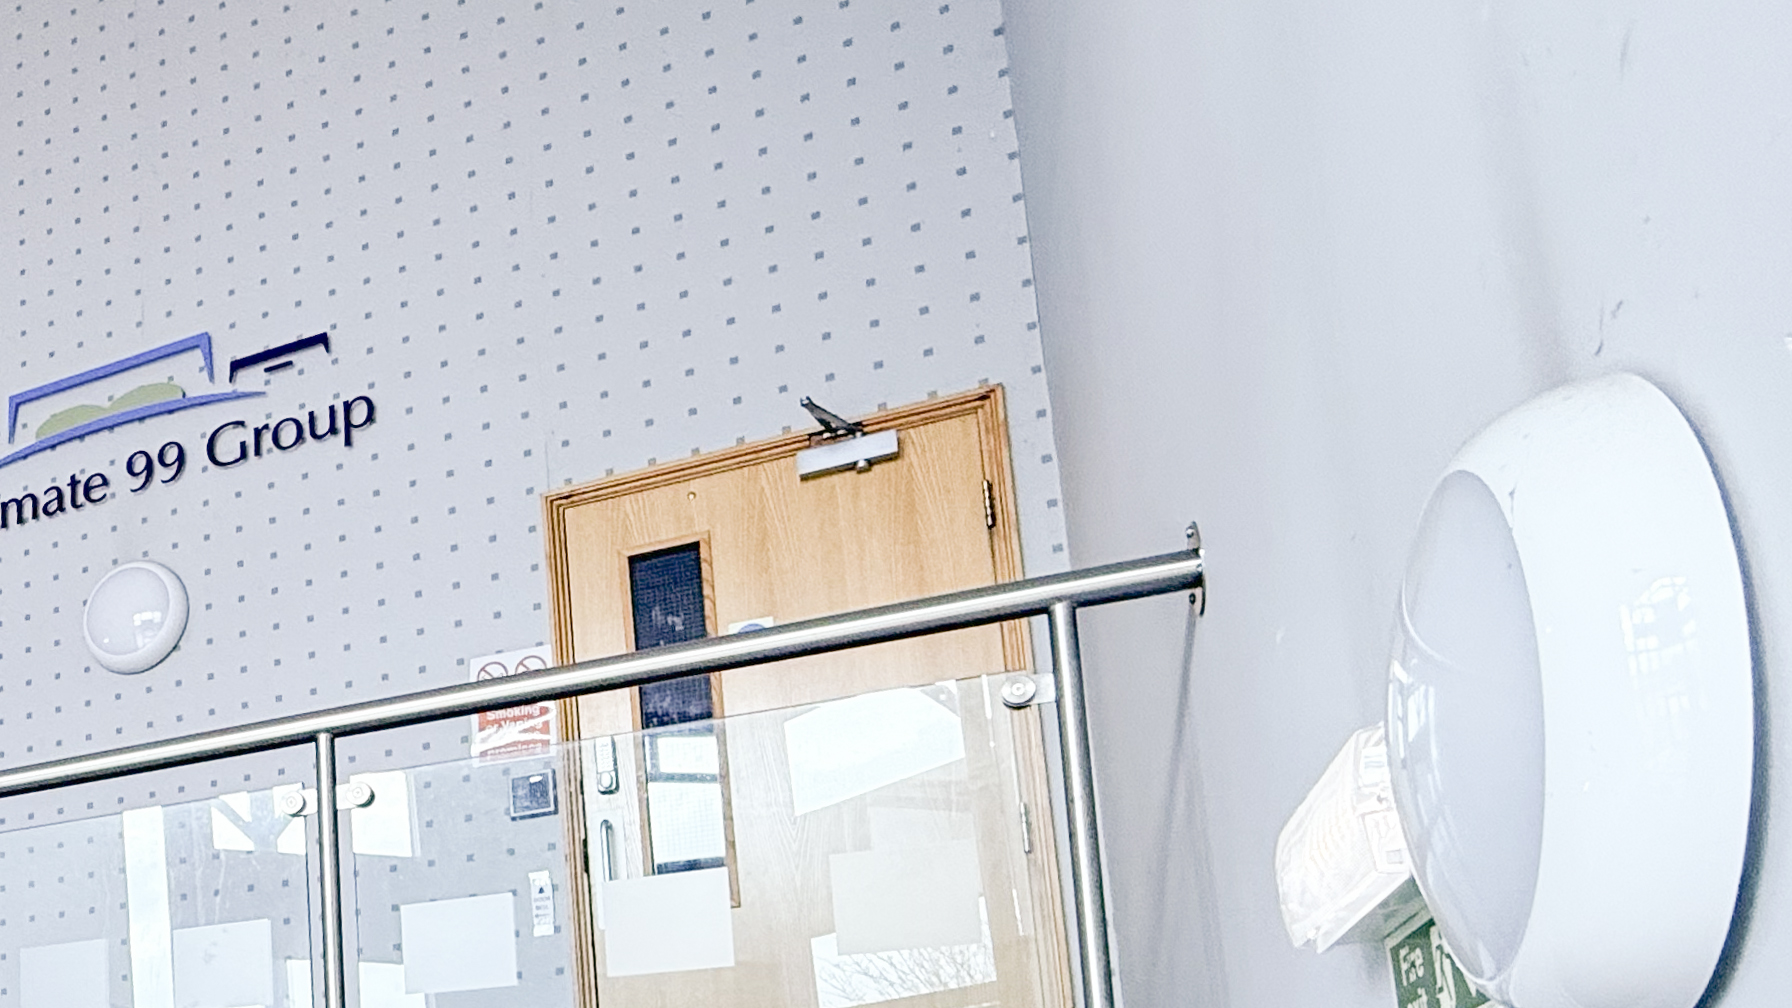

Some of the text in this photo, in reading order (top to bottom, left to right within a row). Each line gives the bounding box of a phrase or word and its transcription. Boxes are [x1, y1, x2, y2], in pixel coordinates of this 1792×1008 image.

[126, 441, 186, 493] 99
[207, 395, 377, 468] Group
[486, 704, 541, 721] Smoking
[1399, 945, 1424, 986] Fire
